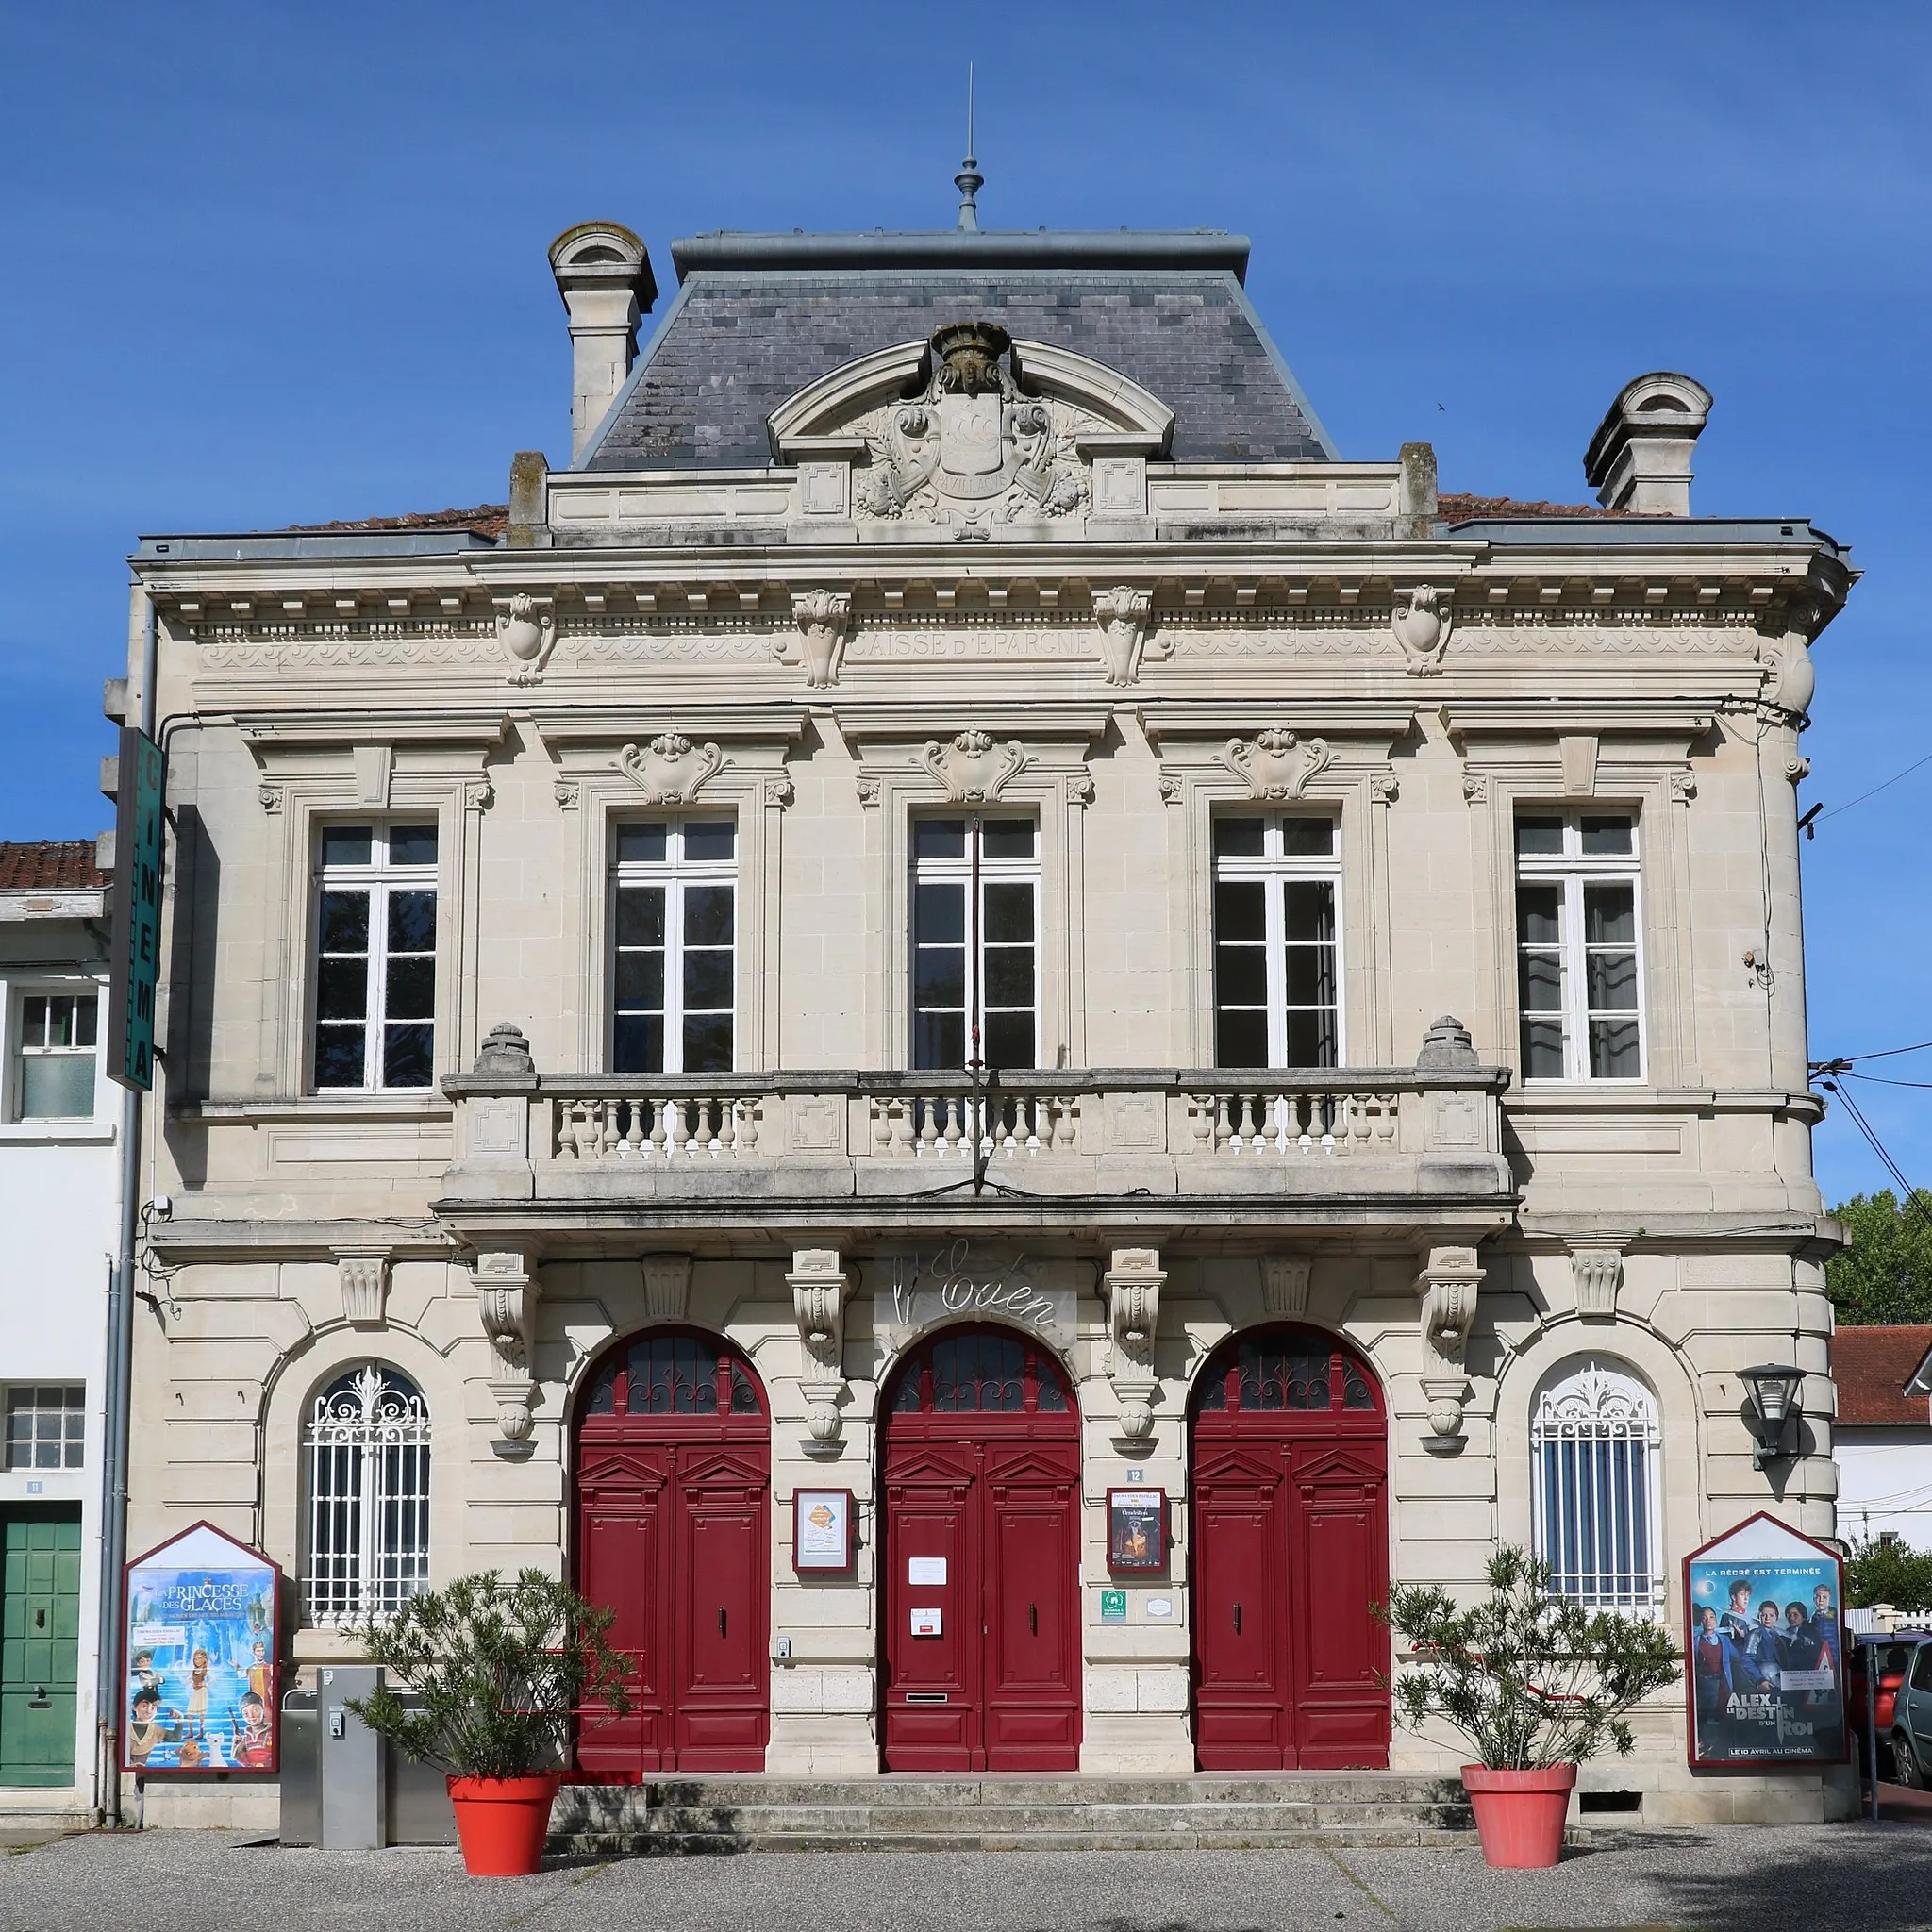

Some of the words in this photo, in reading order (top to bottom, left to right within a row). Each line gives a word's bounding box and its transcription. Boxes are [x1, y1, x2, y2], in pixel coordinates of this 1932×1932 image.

[850, 634, 947, 656] CAISSE
[135, 750, 158, 1083] CINEMA
[1131, 1471, 1141, 1481] 12
[155, 1589, 168, 1597] LA
[168, 1584, 249, 1601] PRINCESSE
[162, 1601, 180, 1609] DES
[1727, 1692, 1771, 1707] ALEX
[1782, 1721, 1814, 1736] ROI
